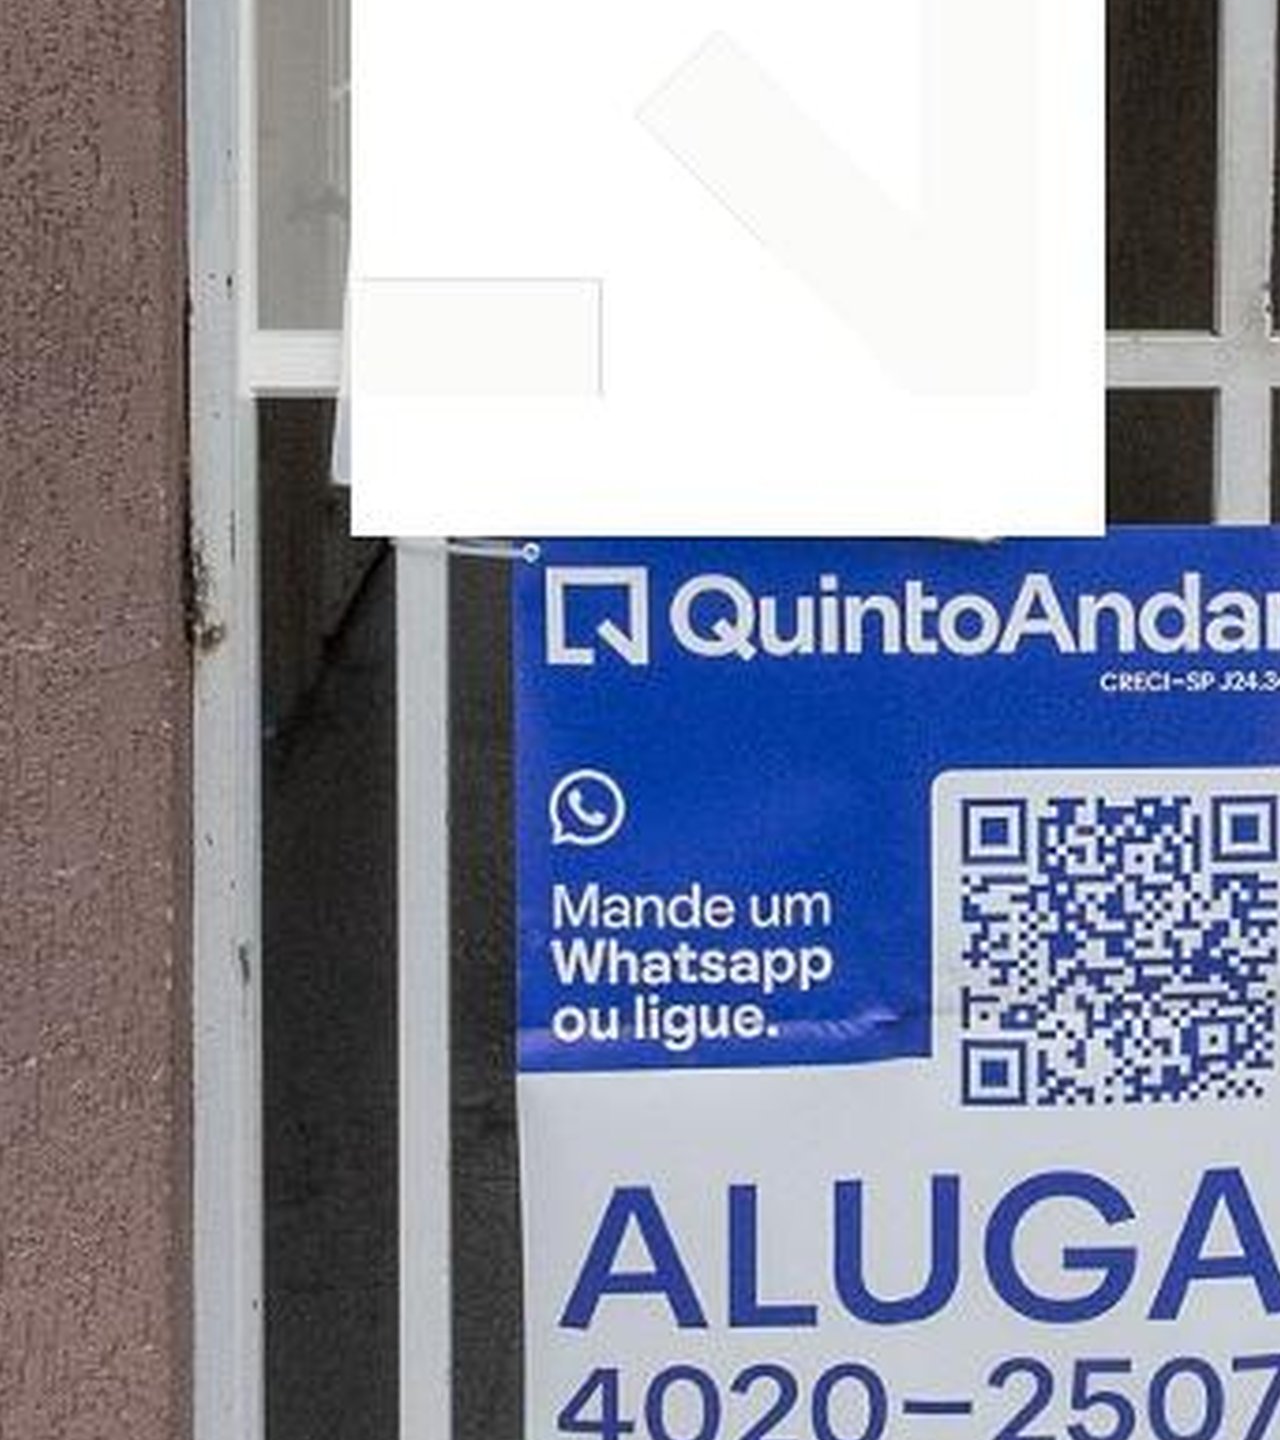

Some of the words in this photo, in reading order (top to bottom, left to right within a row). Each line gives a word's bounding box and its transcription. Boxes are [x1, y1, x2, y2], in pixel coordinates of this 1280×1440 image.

[1099, 670, 1216, 693] CRECI-SP
[552, 881, 736, 930] Mande
[749, 890, 832, 928] um
[549, 937, 834, 995] Whatsapp
[552, 1004, 620, 1044] ou
[634, 992, 780, 1052] ligue.
